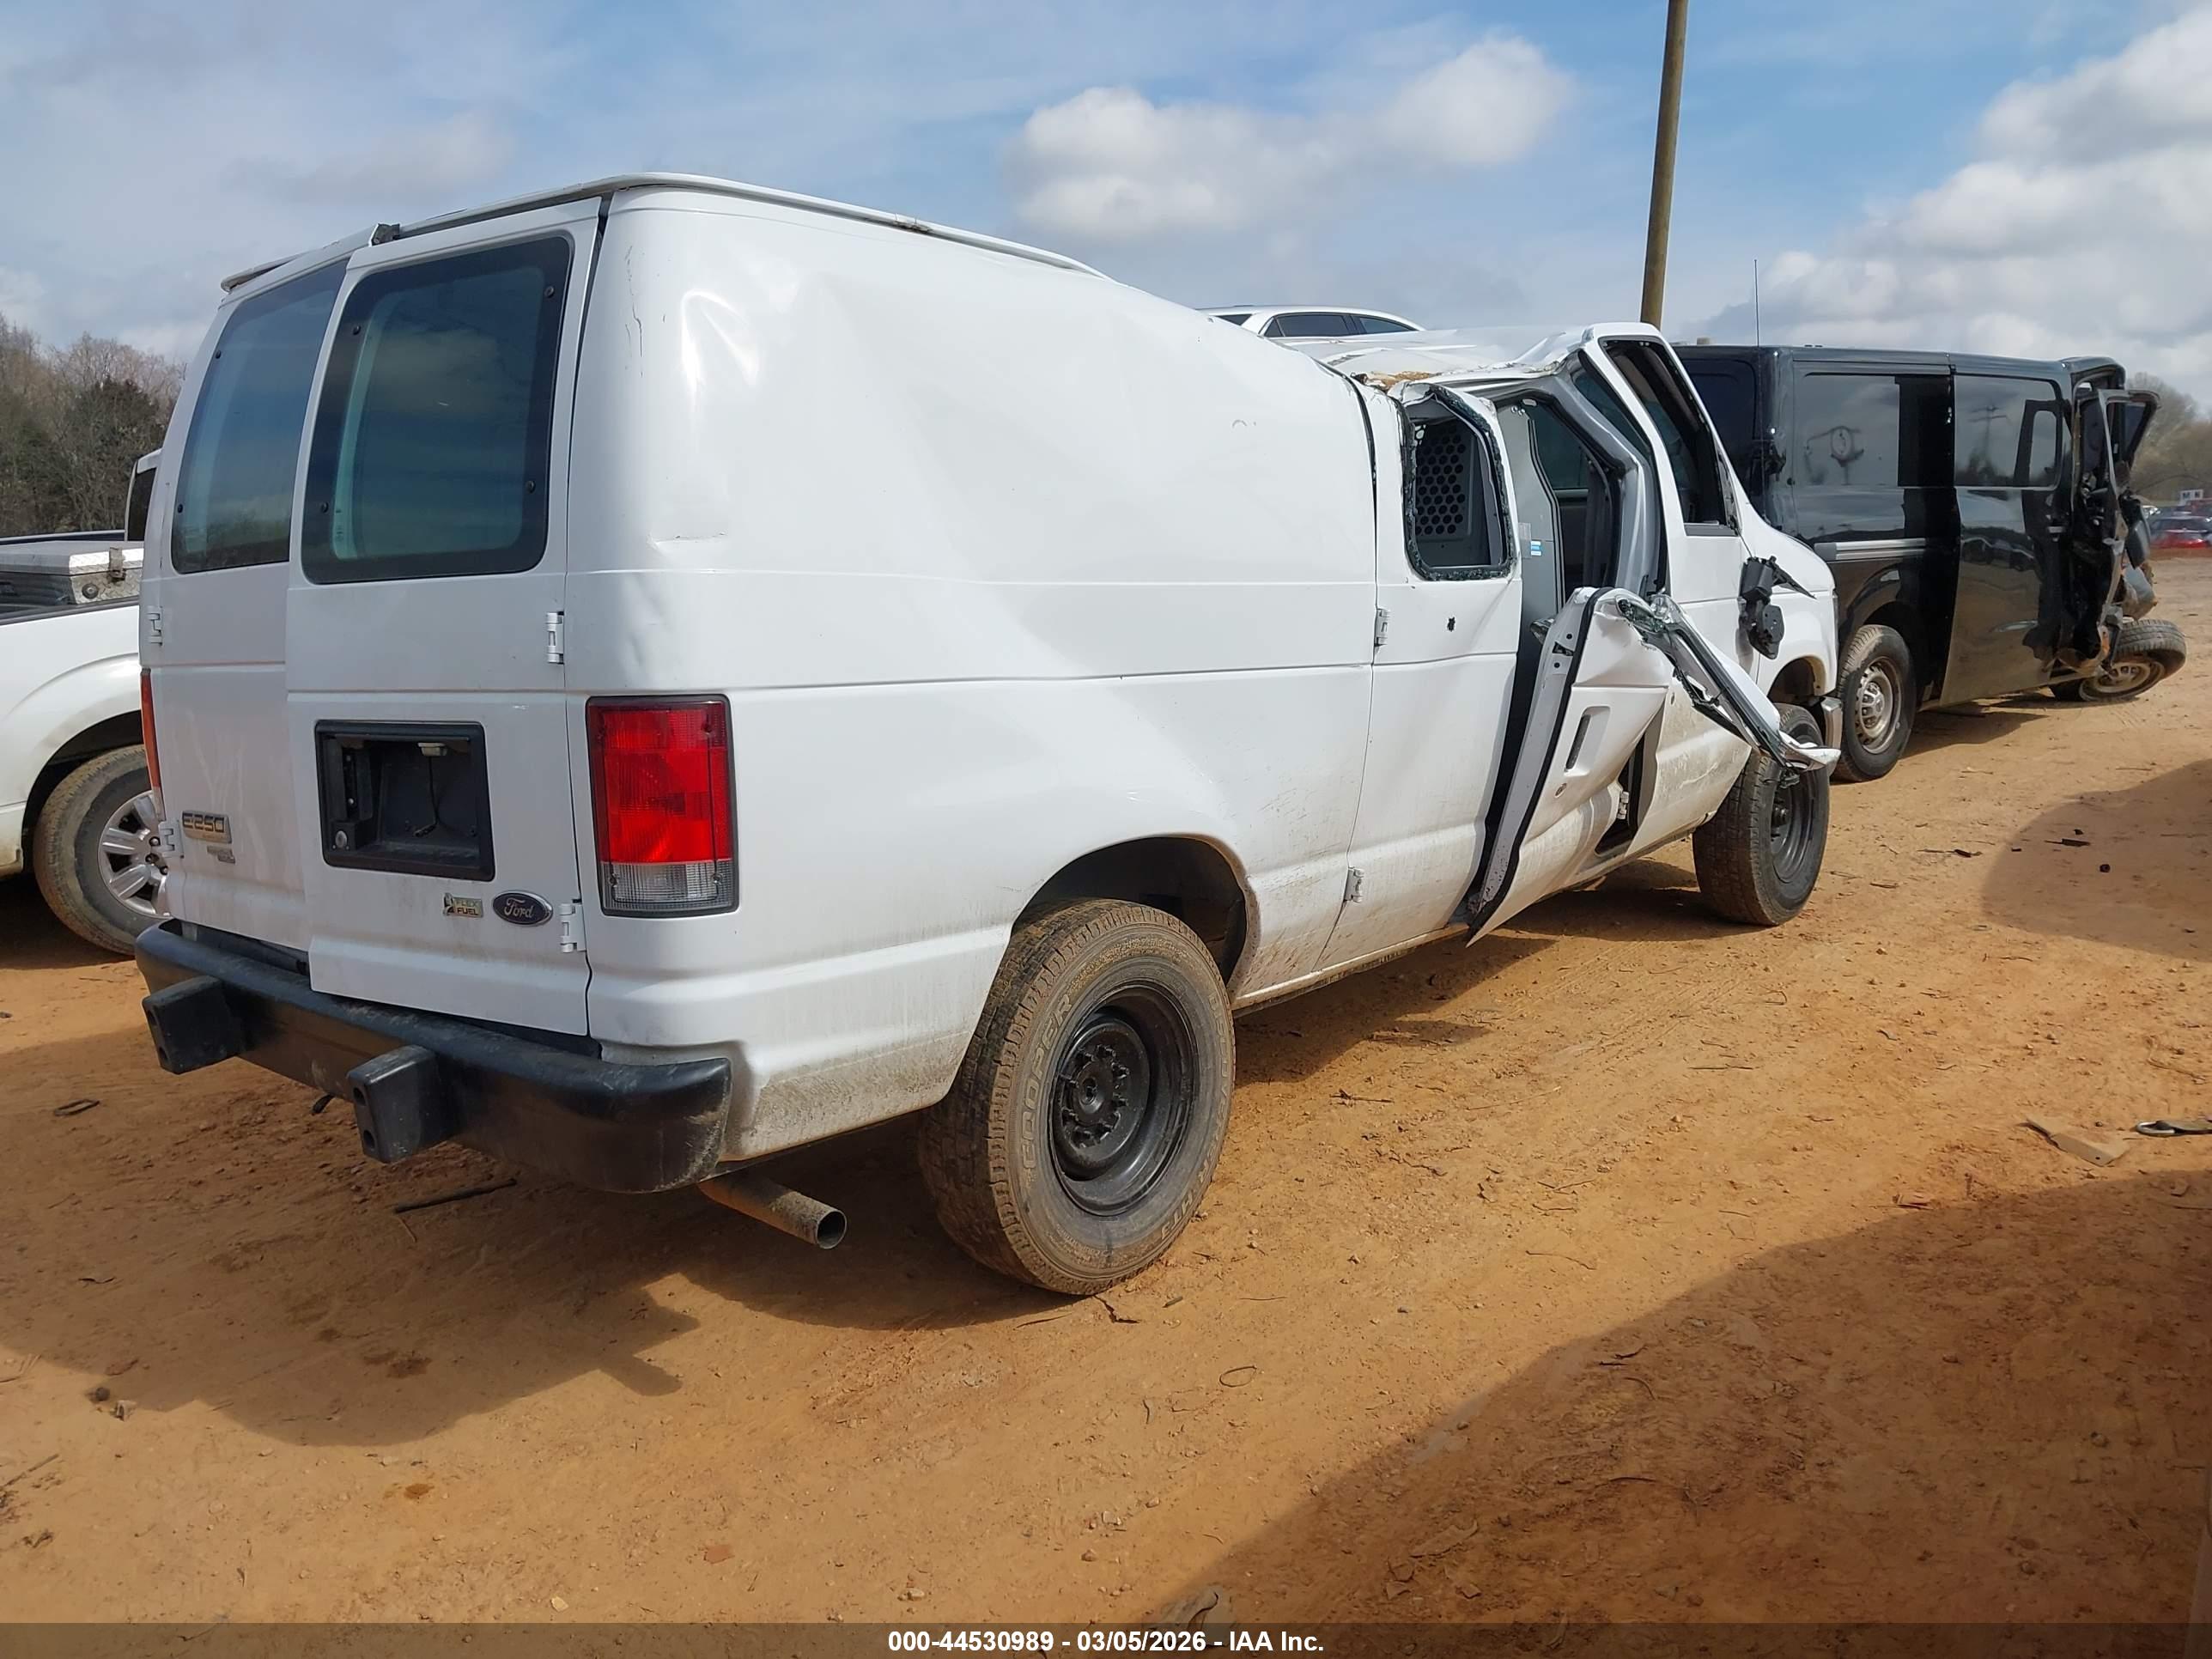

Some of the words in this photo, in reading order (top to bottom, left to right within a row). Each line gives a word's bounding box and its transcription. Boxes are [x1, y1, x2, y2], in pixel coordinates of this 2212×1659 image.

[454, 899, 479, 908] FLEX
[504, 897, 534, 919] Ford
[457, 907, 479, 916] FUEL
[1022, 994, 1073, 1169] COOPER
